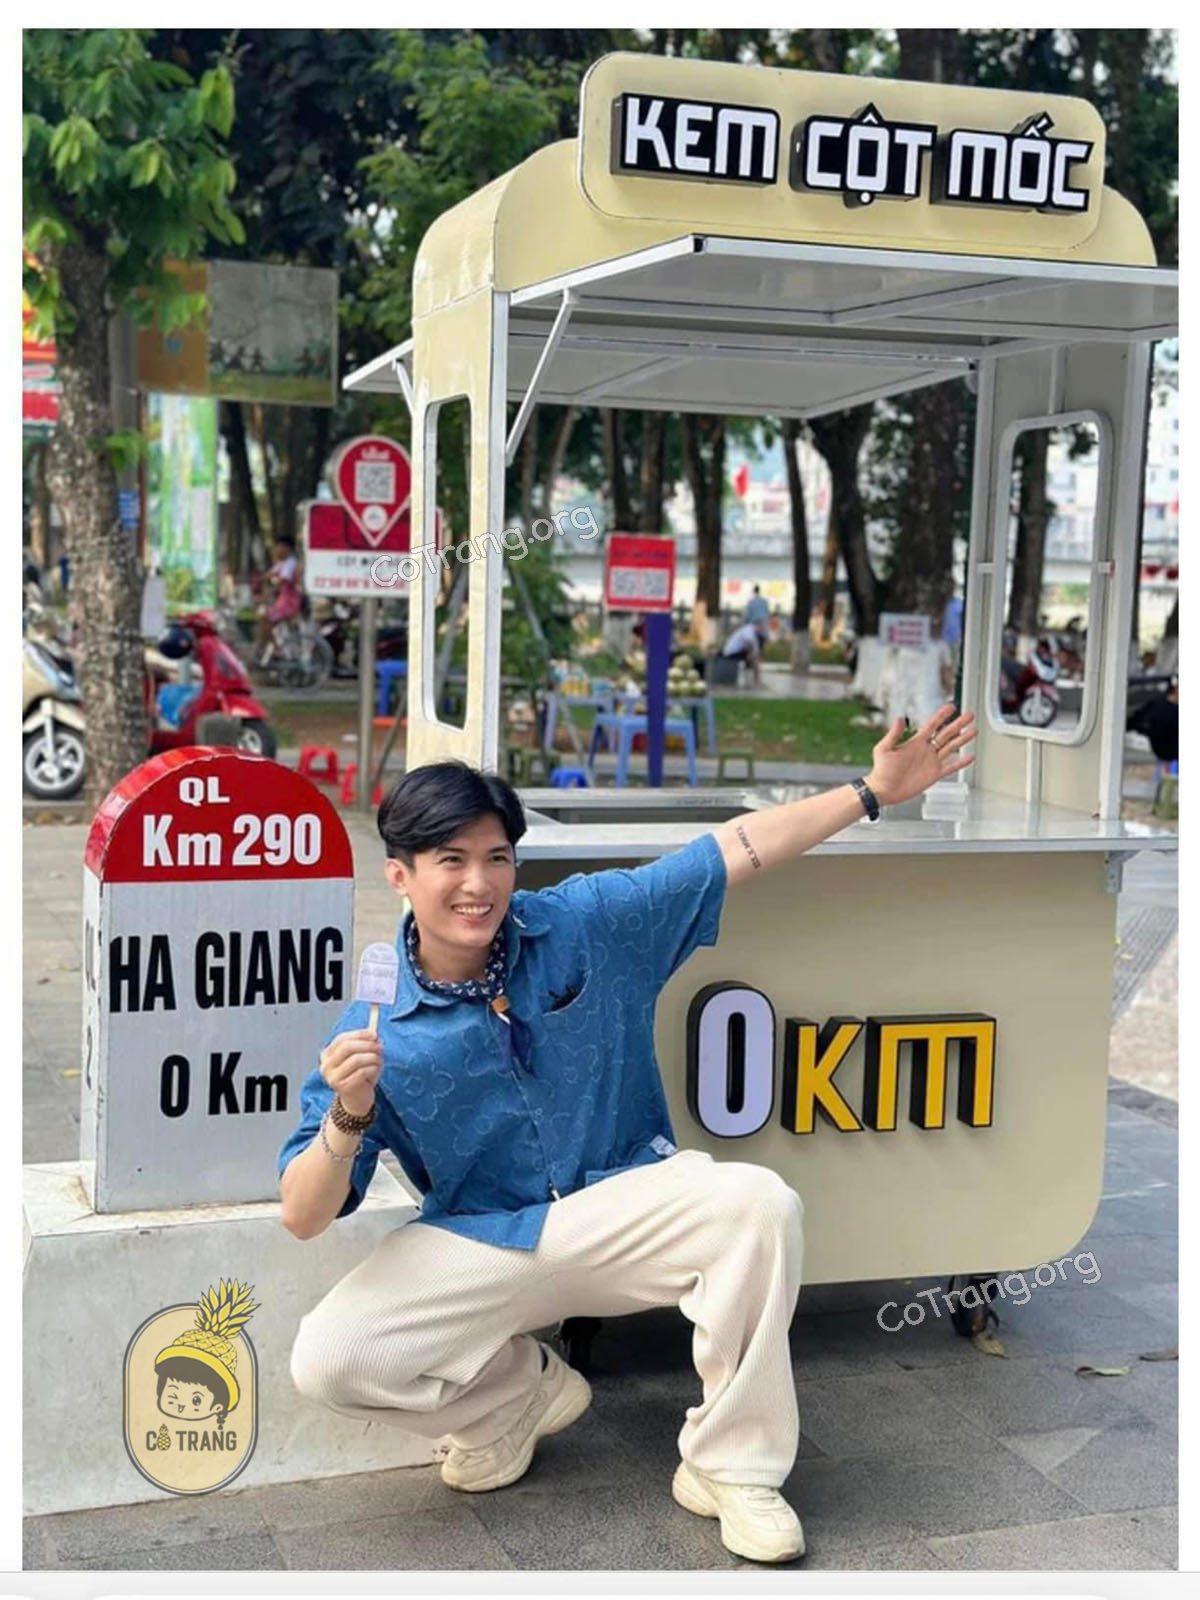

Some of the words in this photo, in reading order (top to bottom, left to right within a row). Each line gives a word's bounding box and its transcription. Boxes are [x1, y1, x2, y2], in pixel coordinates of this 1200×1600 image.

[616, 95, 779, 183] KEM
[800, 106, 937, 206] CỘT
[944, 114, 1093, 210] MỐC
[179, 776, 230, 806] QL
[142, 814, 222, 867] Km
[232, 813, 322, 866] 290
[195, 926, 344, 1010] GIANG
[160, 1054, 190, 1118] 0
[208, 1051, 288, 1116] Km
